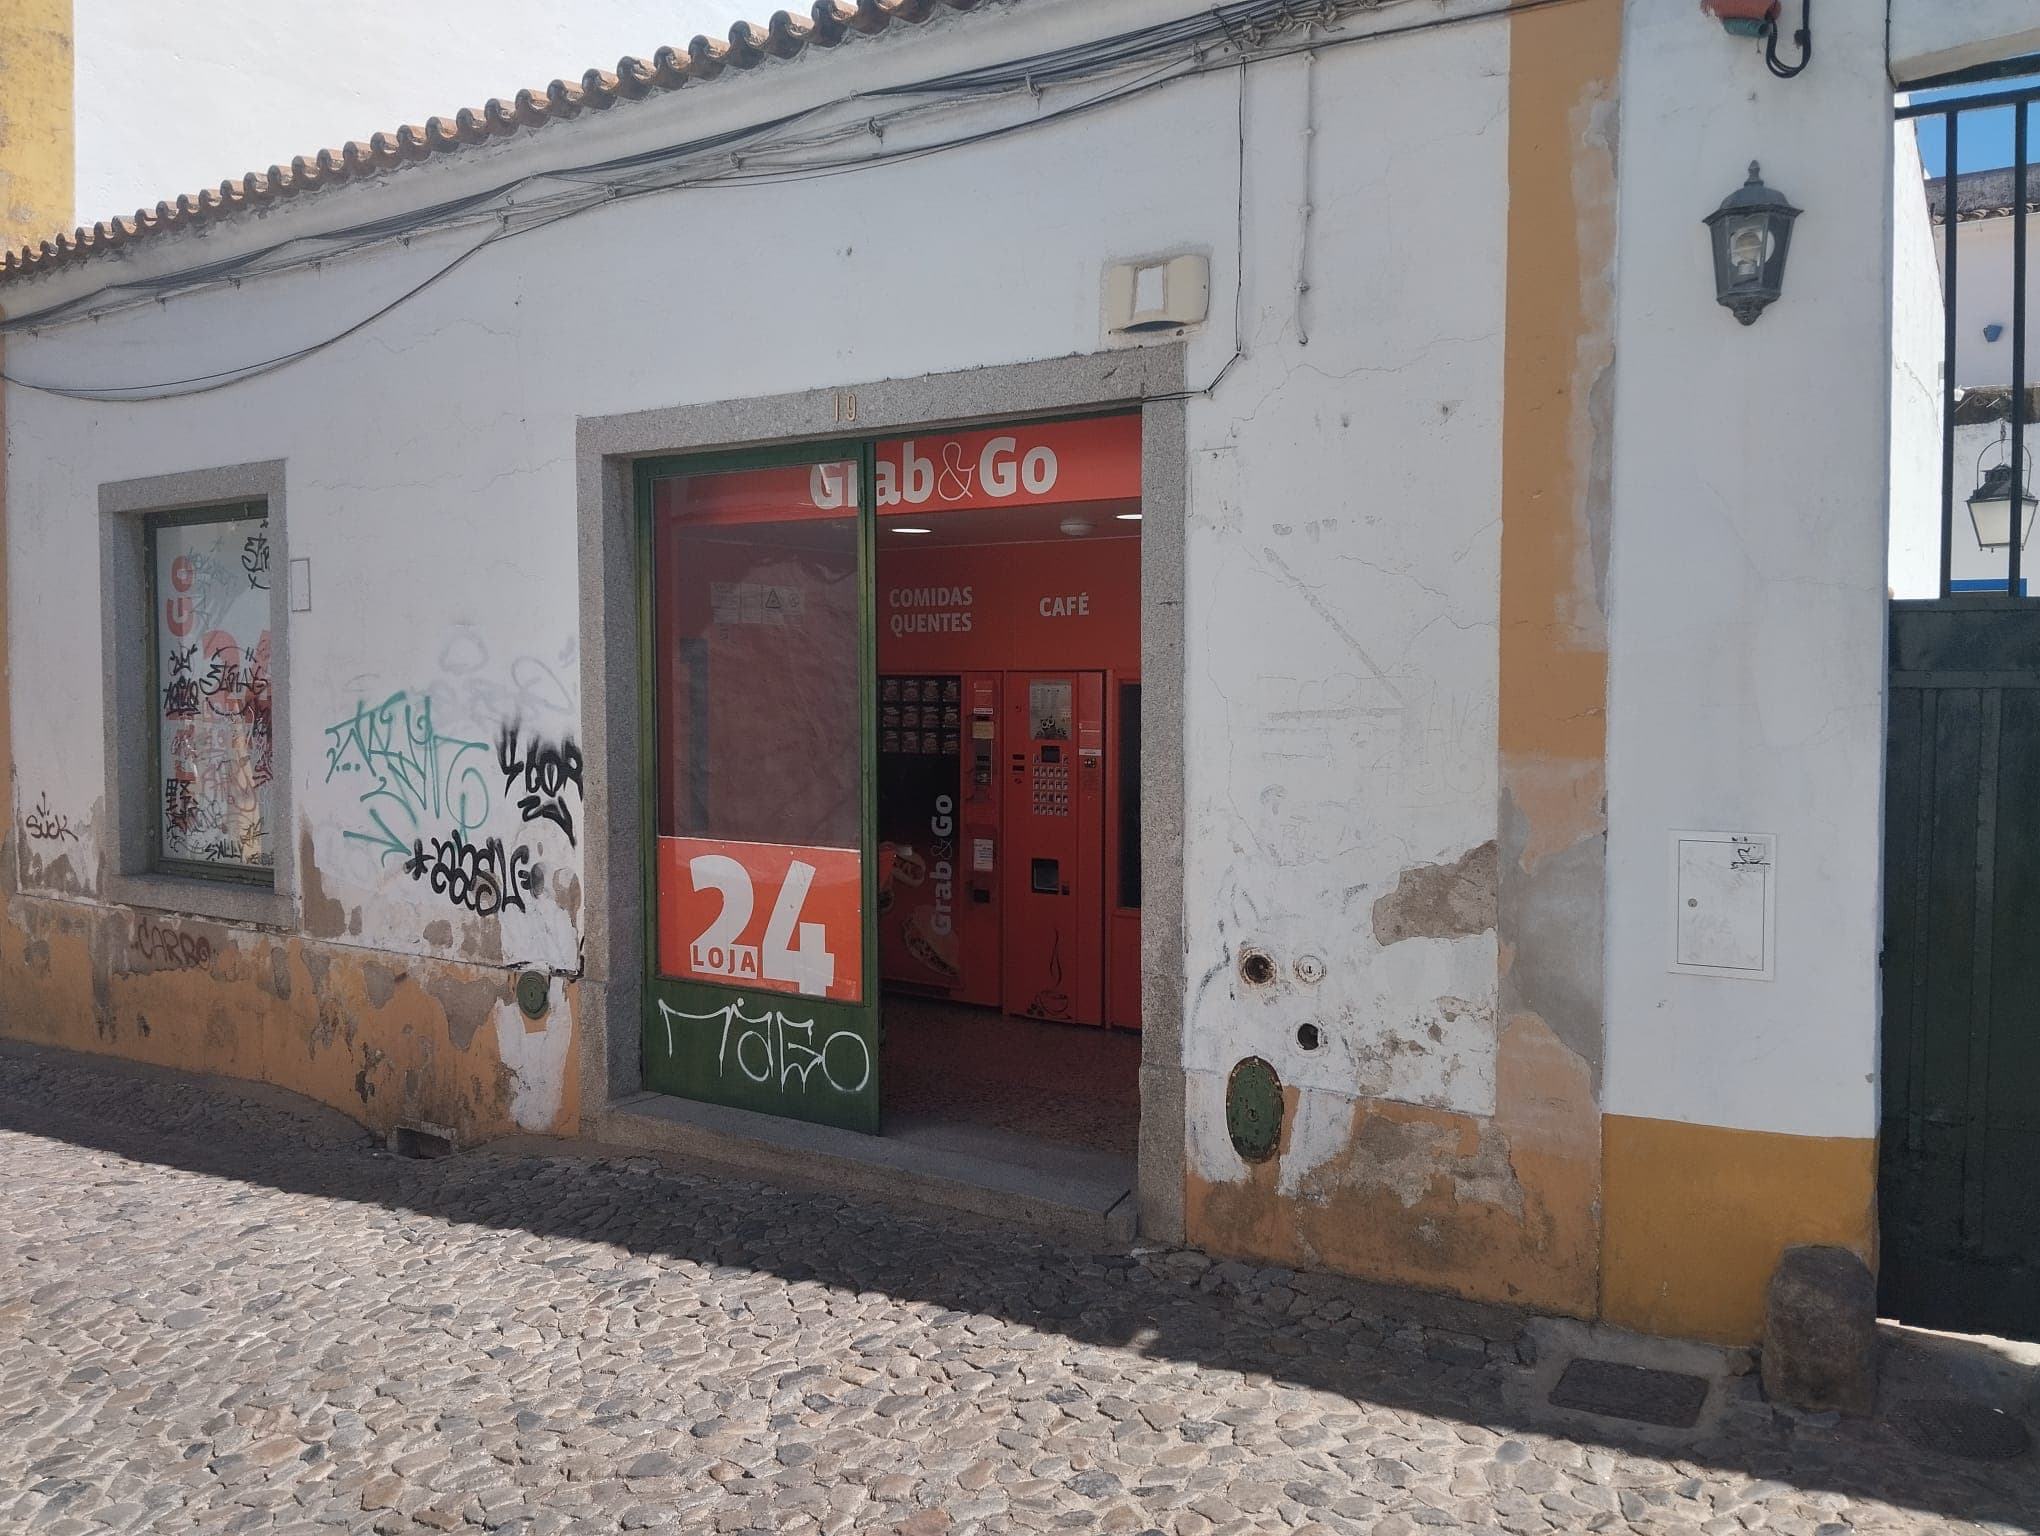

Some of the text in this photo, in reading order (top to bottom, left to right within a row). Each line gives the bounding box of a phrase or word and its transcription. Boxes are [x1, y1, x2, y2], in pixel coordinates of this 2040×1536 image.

[835, 391, 858, 422] 19
[889, 586, 973, 607] COMIDAS
[1039, 592, 1090, 617] CAFÉ
[890, 612, 972, 637] QUENTES
[929, 794, 953, 936] Grab&Go
[690, 854, 835, 997] 24
[692, 945, 757, 974] LOJA
